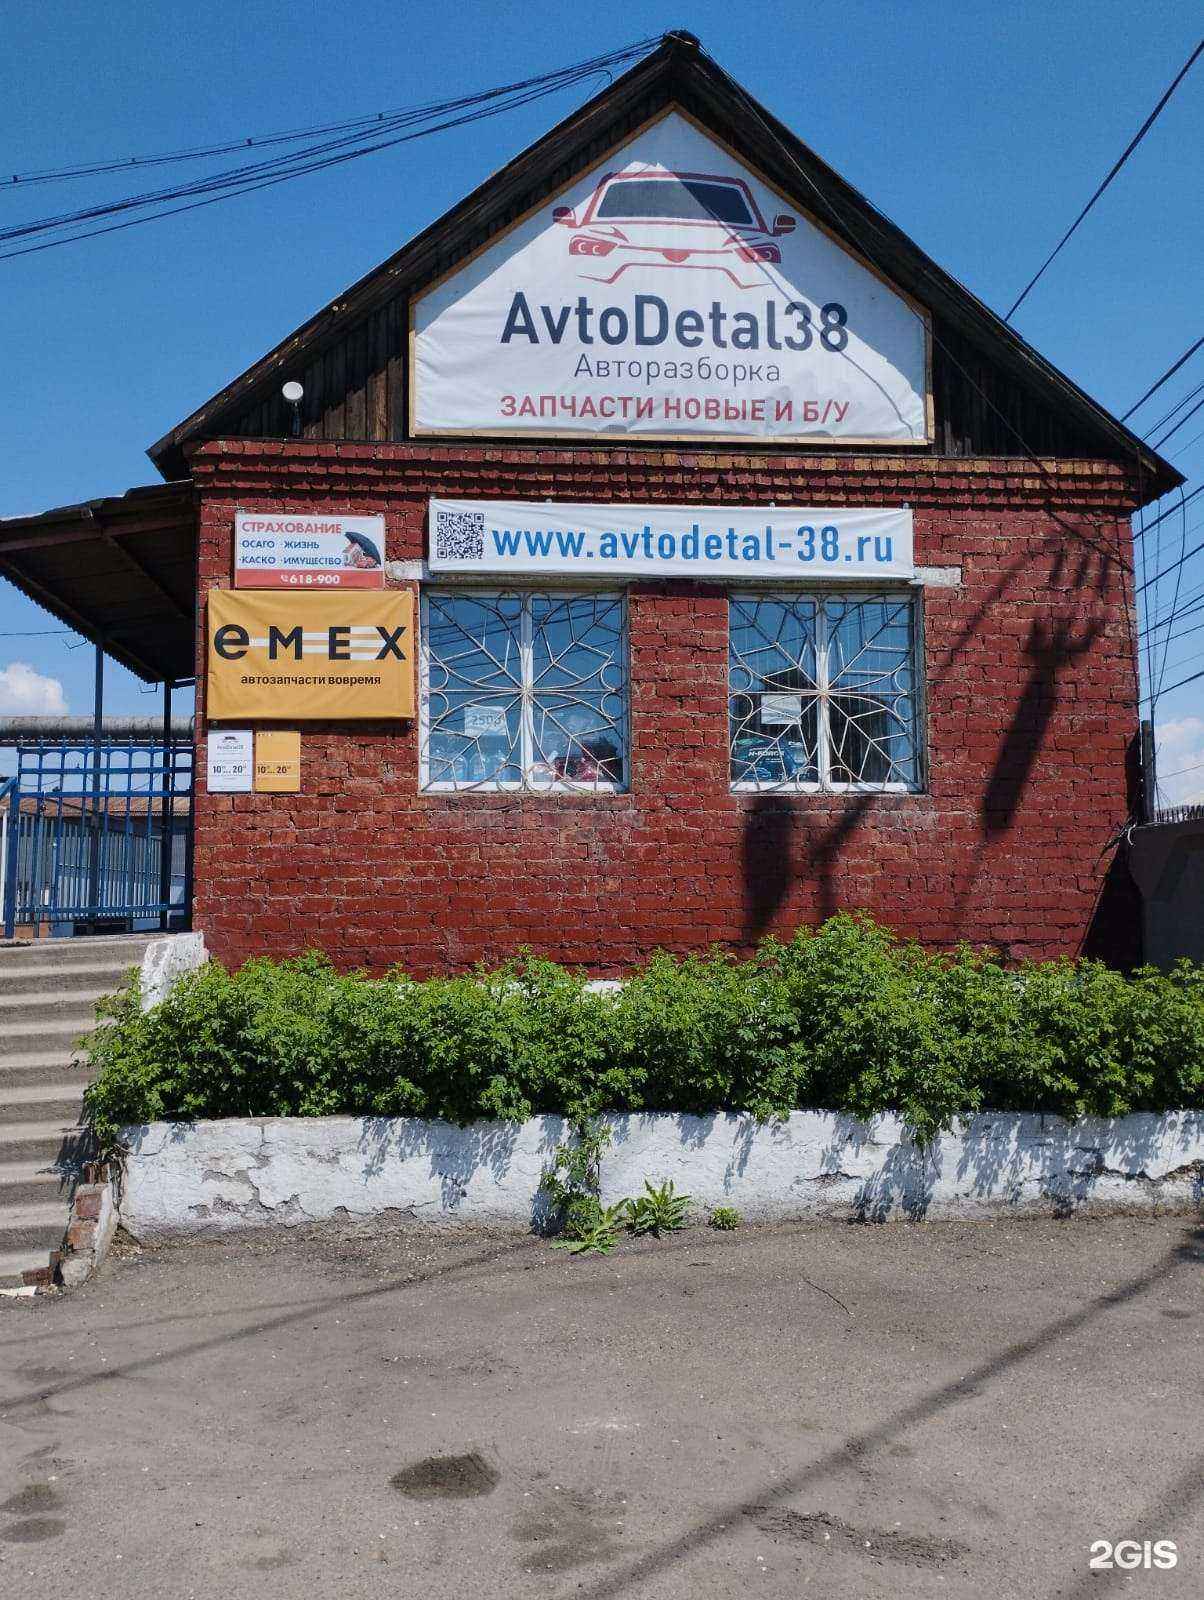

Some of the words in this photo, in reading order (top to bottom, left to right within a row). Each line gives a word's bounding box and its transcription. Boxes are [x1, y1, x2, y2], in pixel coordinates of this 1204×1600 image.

[500, 292, 849, 352] AvtoDetal38
[574, 354, 780, 386] Авторазборка
[500, 396, 653, 419] ЗАПЧАСТИ
[664, 397, 765, 421] НОВЫЕ
[776, 399, 793, 421] И
[803, 400, 850, 424] Б/У
[241, 521, 342, 534] СТРАХОВАНИЕ
[242, 540, 275, 549] ОСАГО
[284, 540, 320, 549] ЖИЗНЬ
[492, 524, 894, 563] www.avtodetal-38.ru
[242, 555, 276, 564] КАСКО
[283, 556, 342, 565] ИМУЩЕСТВО
[289, 574, 340, 584] 618-900
[241, 675, 325, 685] автозапчасти
[328, 676, 381, 687] вовремя
